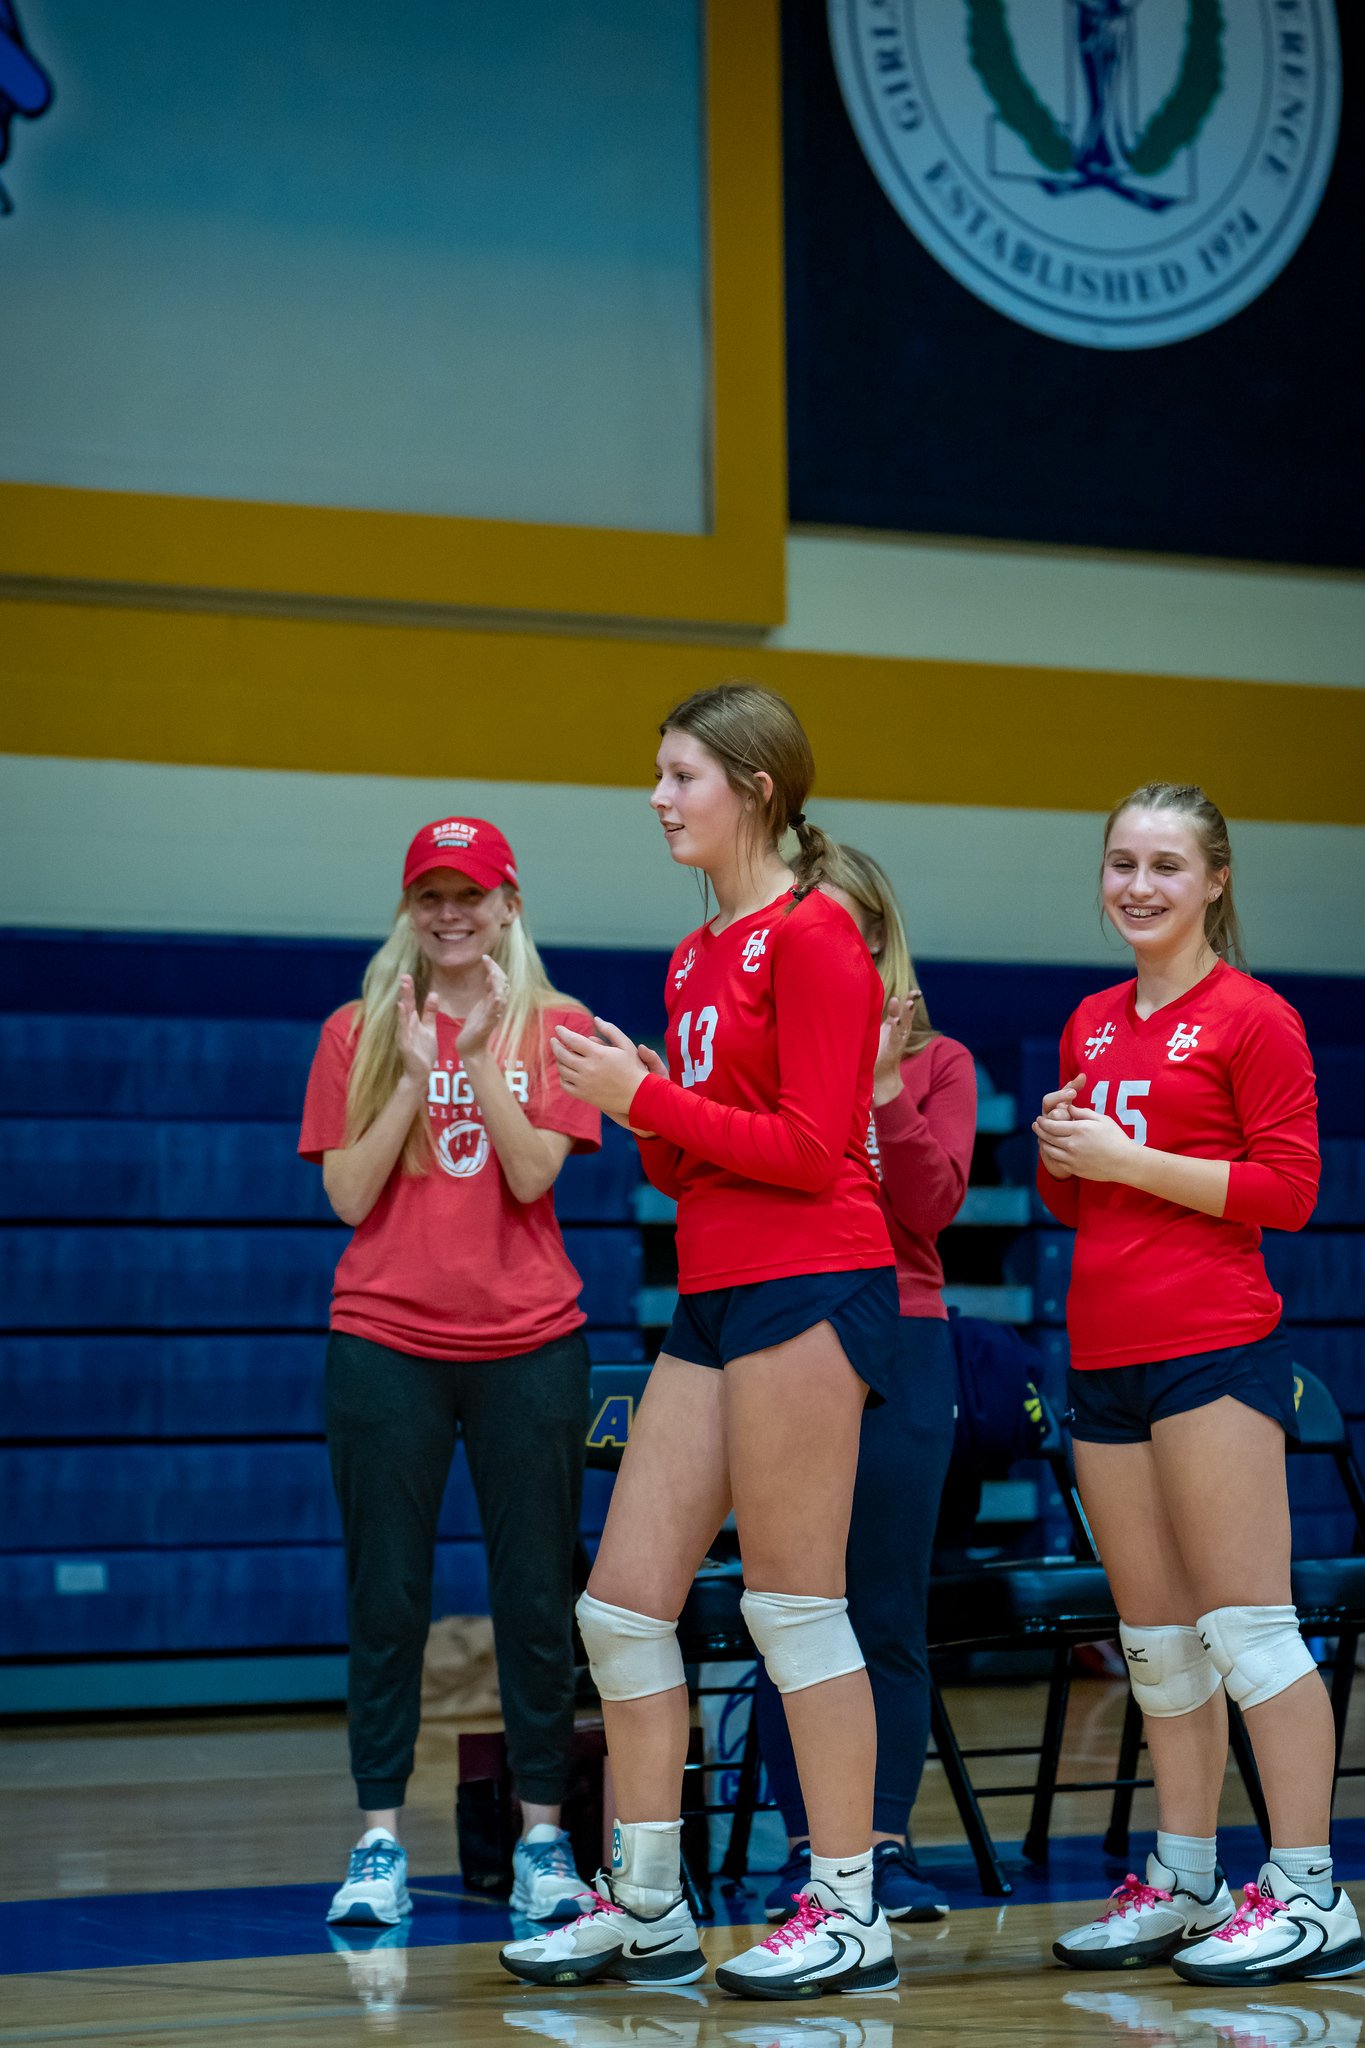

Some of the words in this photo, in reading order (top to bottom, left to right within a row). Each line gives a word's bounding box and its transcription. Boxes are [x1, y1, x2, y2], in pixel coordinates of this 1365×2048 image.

[871, 0, 924, 132] GIRL
[923, 159, 1188, 305] ESTABLISHED
[1199, 208, 1260, 276] 1974
[678, 1005, 718, 1088] 13
[1091, 1080, 1151, 1147] 15
